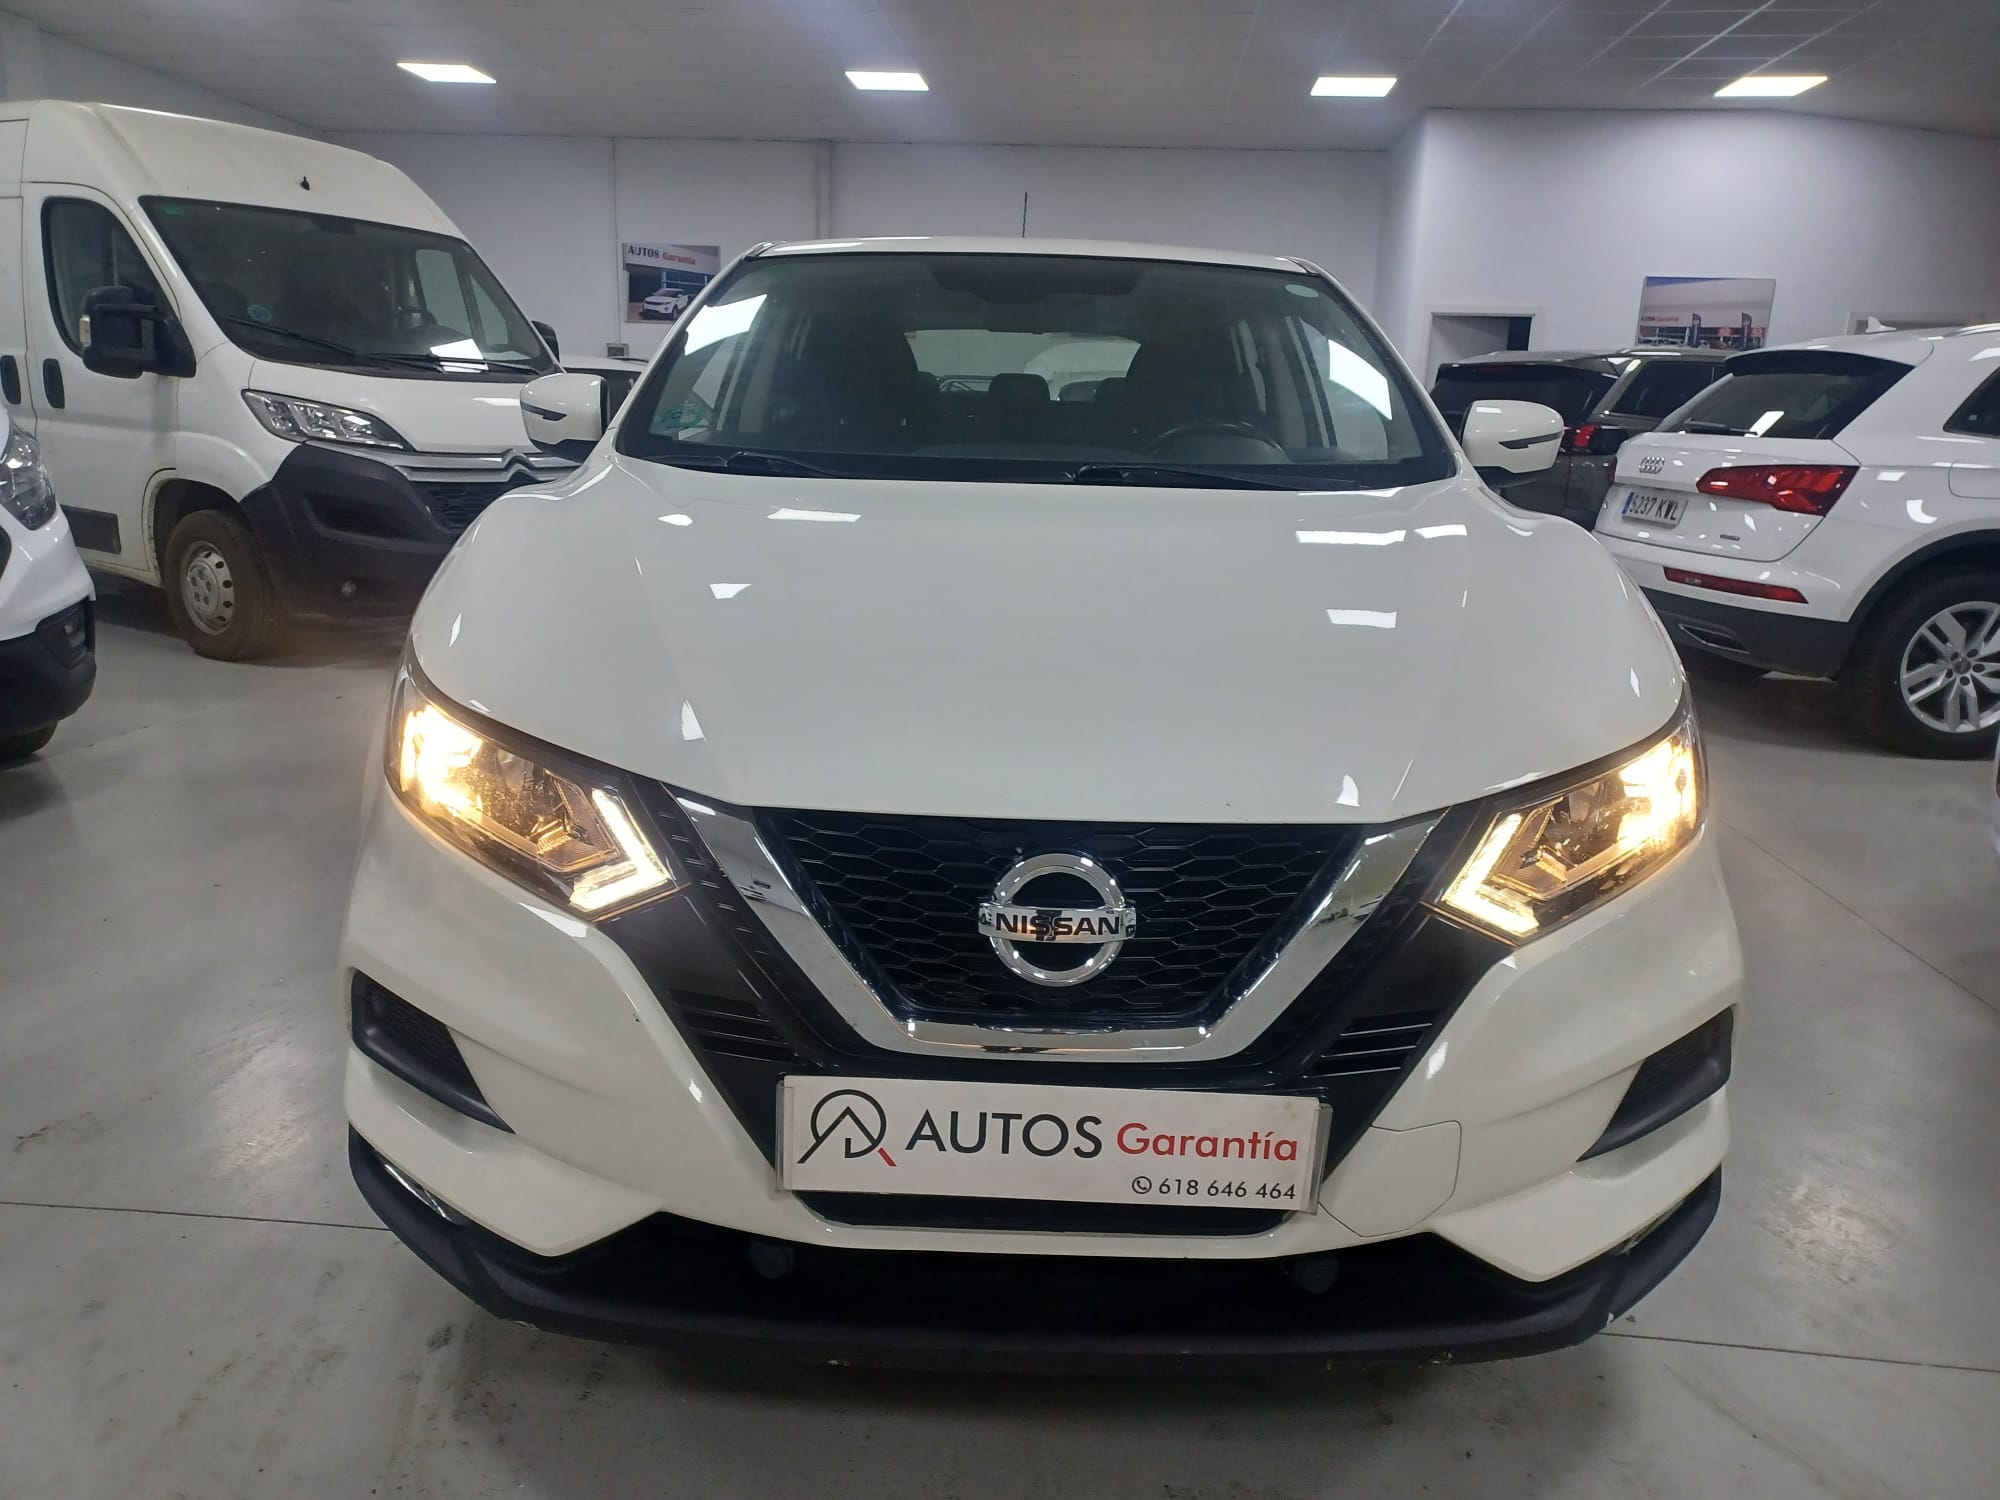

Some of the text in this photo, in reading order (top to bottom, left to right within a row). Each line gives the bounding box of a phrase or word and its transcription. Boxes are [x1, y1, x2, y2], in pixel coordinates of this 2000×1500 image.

[628, 245, 660, 259] AUTOS
[1629, 494, 1658, 516] 5237
[995, 913, 1120, 936] NISSAN
[905, 1109, 1297, 1161] AUTOS Garantía
[1159, 1178, 1296, 1200] 618 646 464
